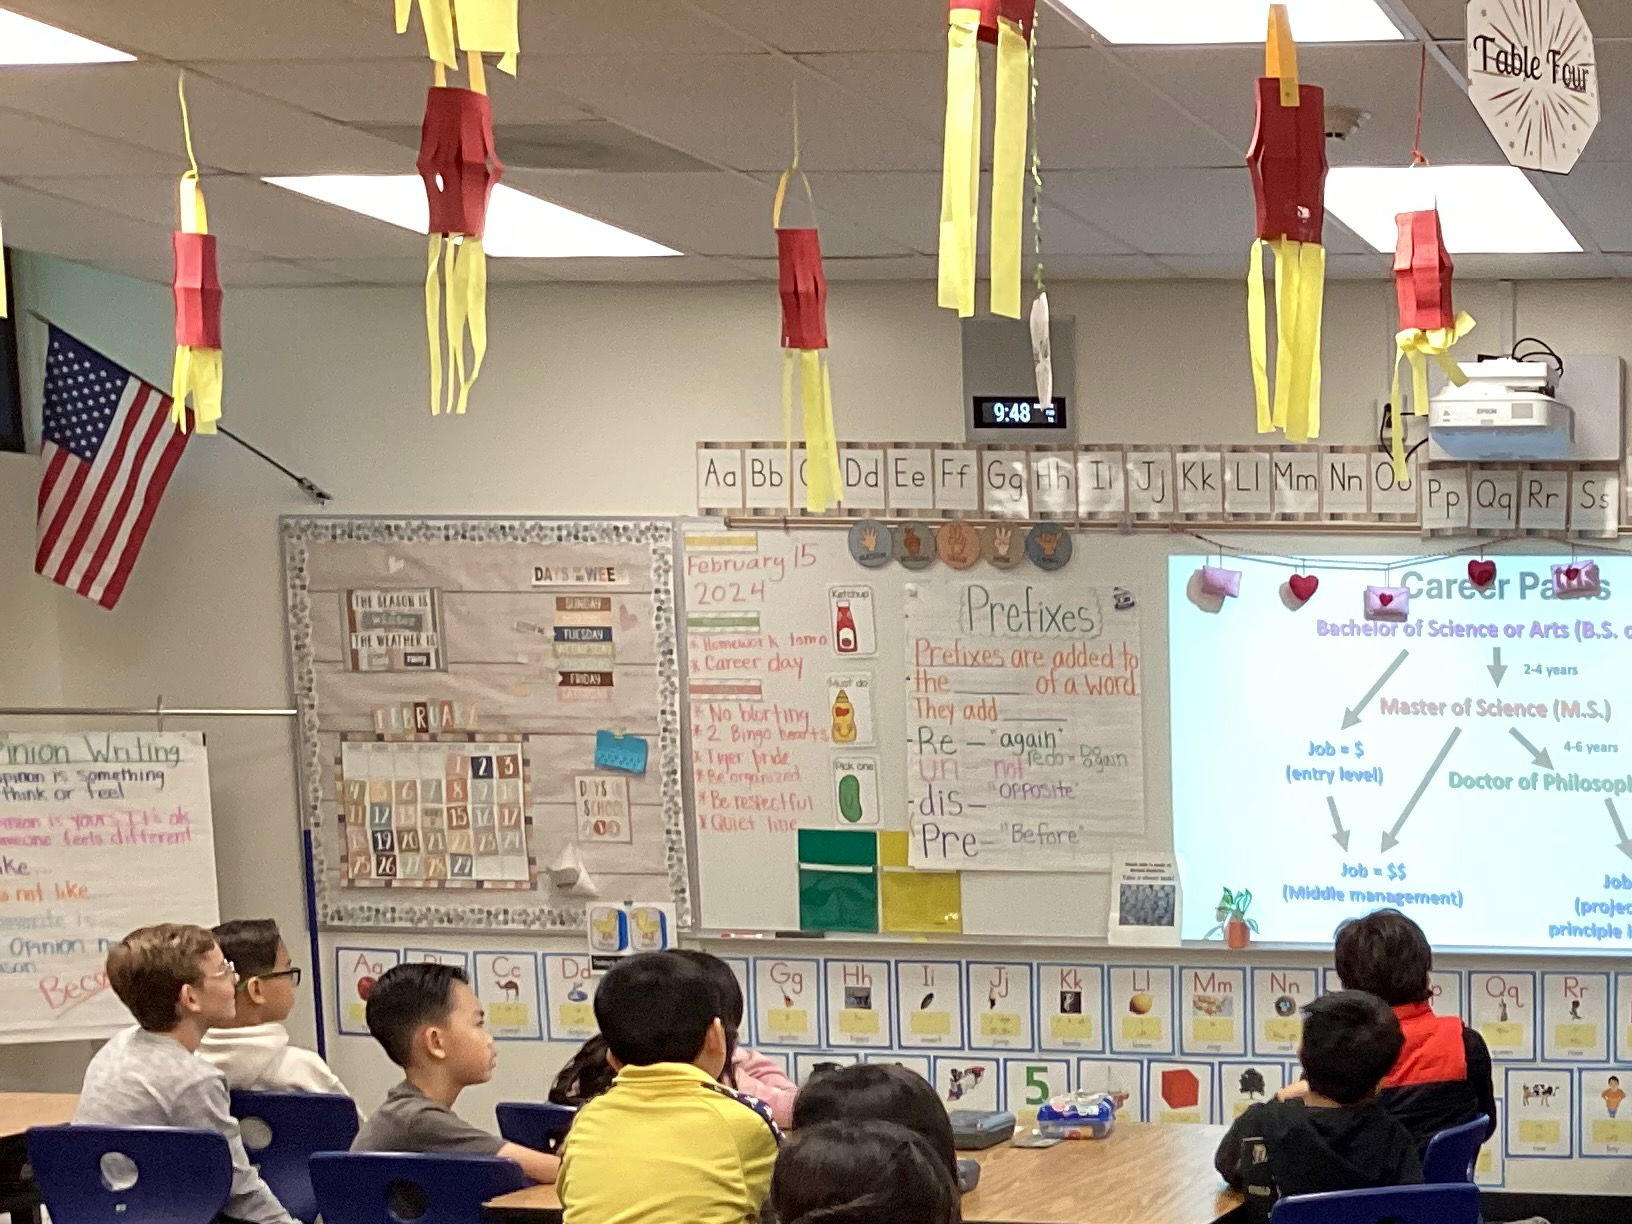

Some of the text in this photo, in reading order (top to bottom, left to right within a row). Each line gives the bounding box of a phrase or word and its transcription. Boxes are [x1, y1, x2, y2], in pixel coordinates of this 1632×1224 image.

[1473, 35, 1589, 91] Table Four
[993, 402, 1031, 423] 9:48
[705, 457, 737, 489] Aa
[751, 458, 784, 488] Bb
[845, 457, 880, 488] Dd
[894, 457, 926, 488] Ee
[941, 458, 968, 489] Ff
[987, 459, 1023, 501] Gg
[1035, 459, 1070, 490] Hh
[1135, 460, 1166, 503] Jj
[1182, 462, 1215, 492] Kk
[1236, 461, 1260, 492] Ll
[1273, 460, 1318, 492] Mm
[1330, 462, 1363, 492] Nn
[1428, 479, 1460, 519] Pp
[1476, 479, 1513, 520] Qq
[1528, 480, 1559, 508] Rr
[1580, 480, 1609, 509] Ss
[687, 543, 818, 582] February 15
[694, 580, 765, 605] 2024
[831, 588, 870, 600] Ketchup
[967, 584, 1096, 633] Prefixes
[563, 629, 604, 640] TUESDAY
[1316, 619, 1398, 638] Bachelor
[1403, 619, 1424, 638] of
[1428, 619, 1499, 639] Science
[1503, 622, 1526, 639] or
[1529, 620, 1570, 639] Arts
[1574, 619, 1618, 643] (B.S.
[703, 635, 779, 652] Homework
[915, 638, 1139, 671] Prefixes are added to
[705, 653, 803, 680] Career day
[1523, 663, 1579, 678] 2-4 years
[569, 673, 601, 685] FRIDAY
[916, 669, 1078, 695] the of a
[709, 703, 732, 723] No
[916, 696, 999, 725] They add
[1380, 697, 1612, 723] Master of Science (M.S.)
[730, 725, 771, 747] Bingo
[83, 734, 181, 768] Writing
[1308, 740, 1365, 759] Job $
[1563, 741, 1619, 755] 4-6 years
[478, 757, 514, 776] 2 3
[1285, 765, 1384, 786] (entry level)
[76, 768, 165, 791] something
[1449, 771, 1514, 791] Doctor
[1518, 772, 1539, 791] of
[449, 808, 467, 825] 15
[374, 831, 392, 850] 19
[378, 856, 396, 874] 26
[1341, 862, 1407, 881] Job $$
[1603, 873, 1632, 890] Job
[1283, 884, 1464, 909] (Middle management)
[1549, 921, 1622, 940] principle
[354, 953, 383, 975] Aa
[492, 956, 521, 978] Cc
[562, 958, 592, 980] Dd
[770, 962, 804, 994] Gg
[843, 964, 872, 985] Hh
[922, 965, 935, 986] Ii
[990, 966, 1009, 998] Jj
[1060, 968, 1083, 990] Kk
[1133, 969, 1150, 992] Ll
[1193, 971, 1233, 993] Mm
[1271, 972, 1300, 994] Nn
[1485, 976, 1525, 1008] Qq
[1563, 977, 1588, 998] Rr
[1024, 1066, 1051, 1106] 5
